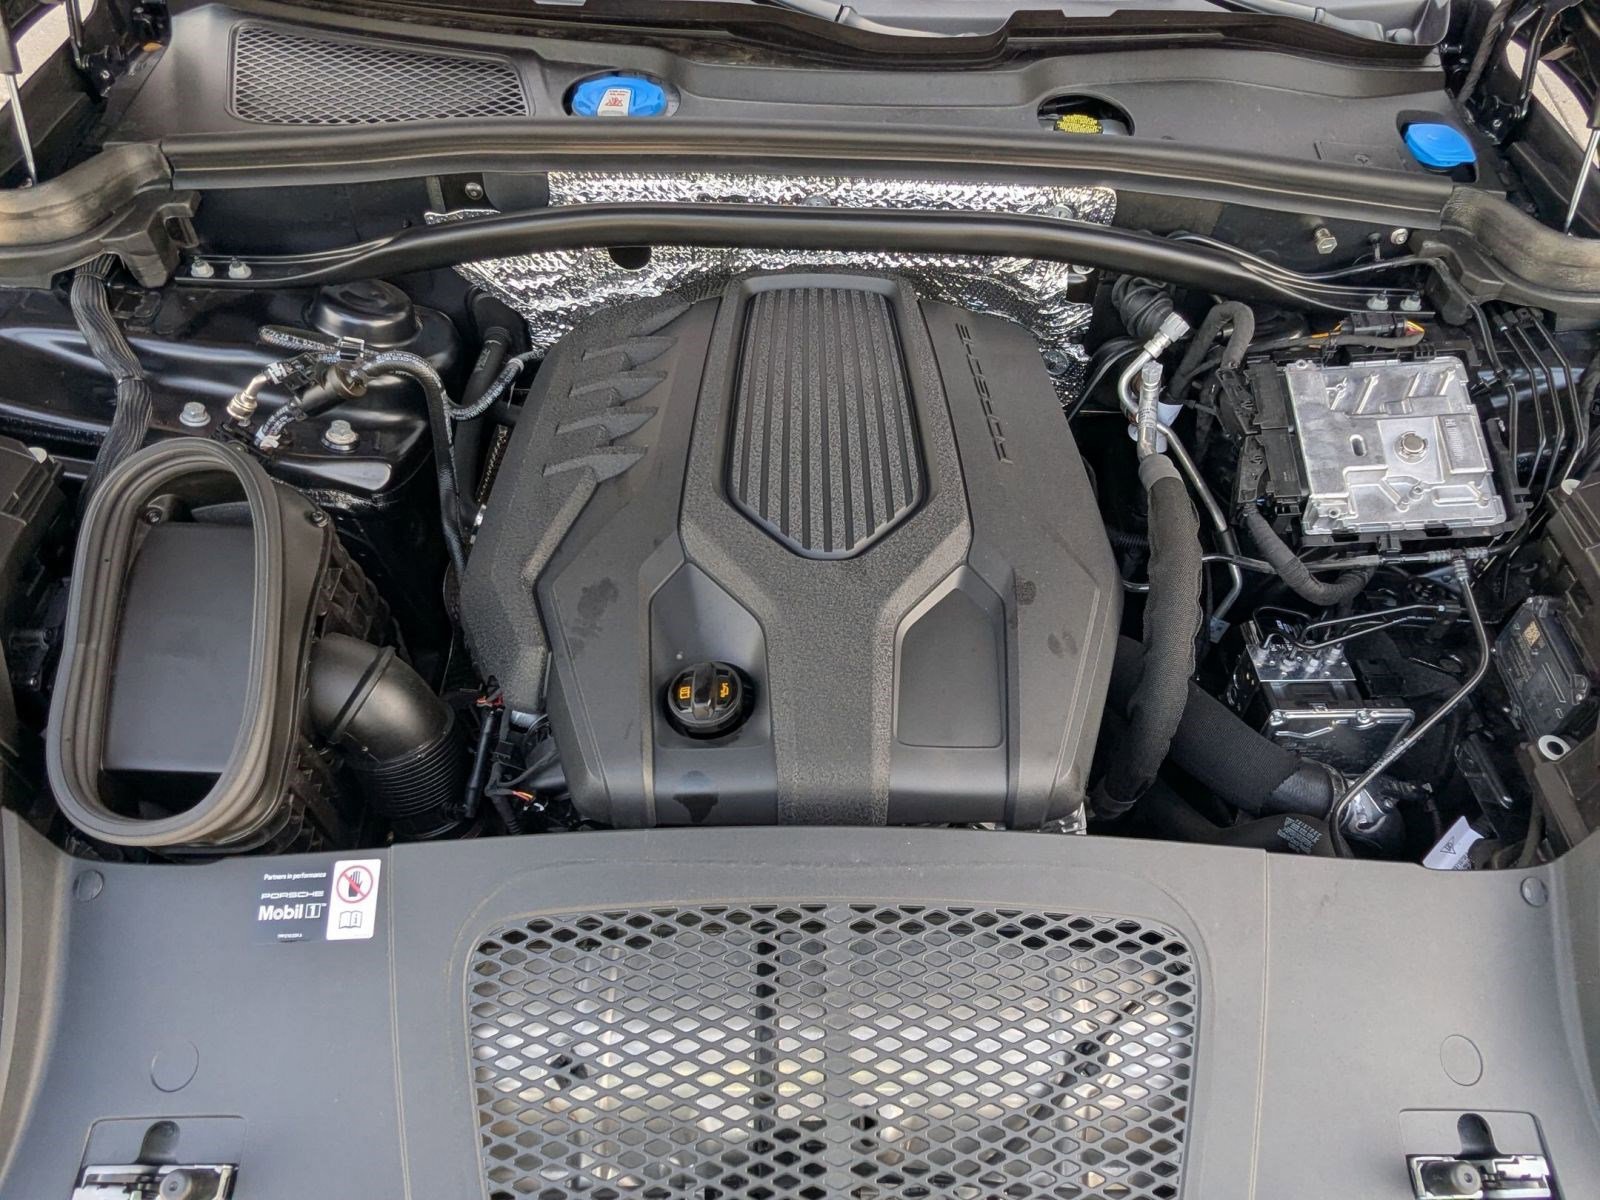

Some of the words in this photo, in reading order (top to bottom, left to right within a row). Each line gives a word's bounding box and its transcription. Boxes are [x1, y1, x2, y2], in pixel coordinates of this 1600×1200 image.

[955, 323, 1013, 464] PORSCHE
[263, 873, 286, 881] Partners
[287, 872, 292, 880] in
[292, 872, 327, 880] performance
[260, 890, 325, 900] PORSCHE
[258, 903, 304, 921] Mobil
